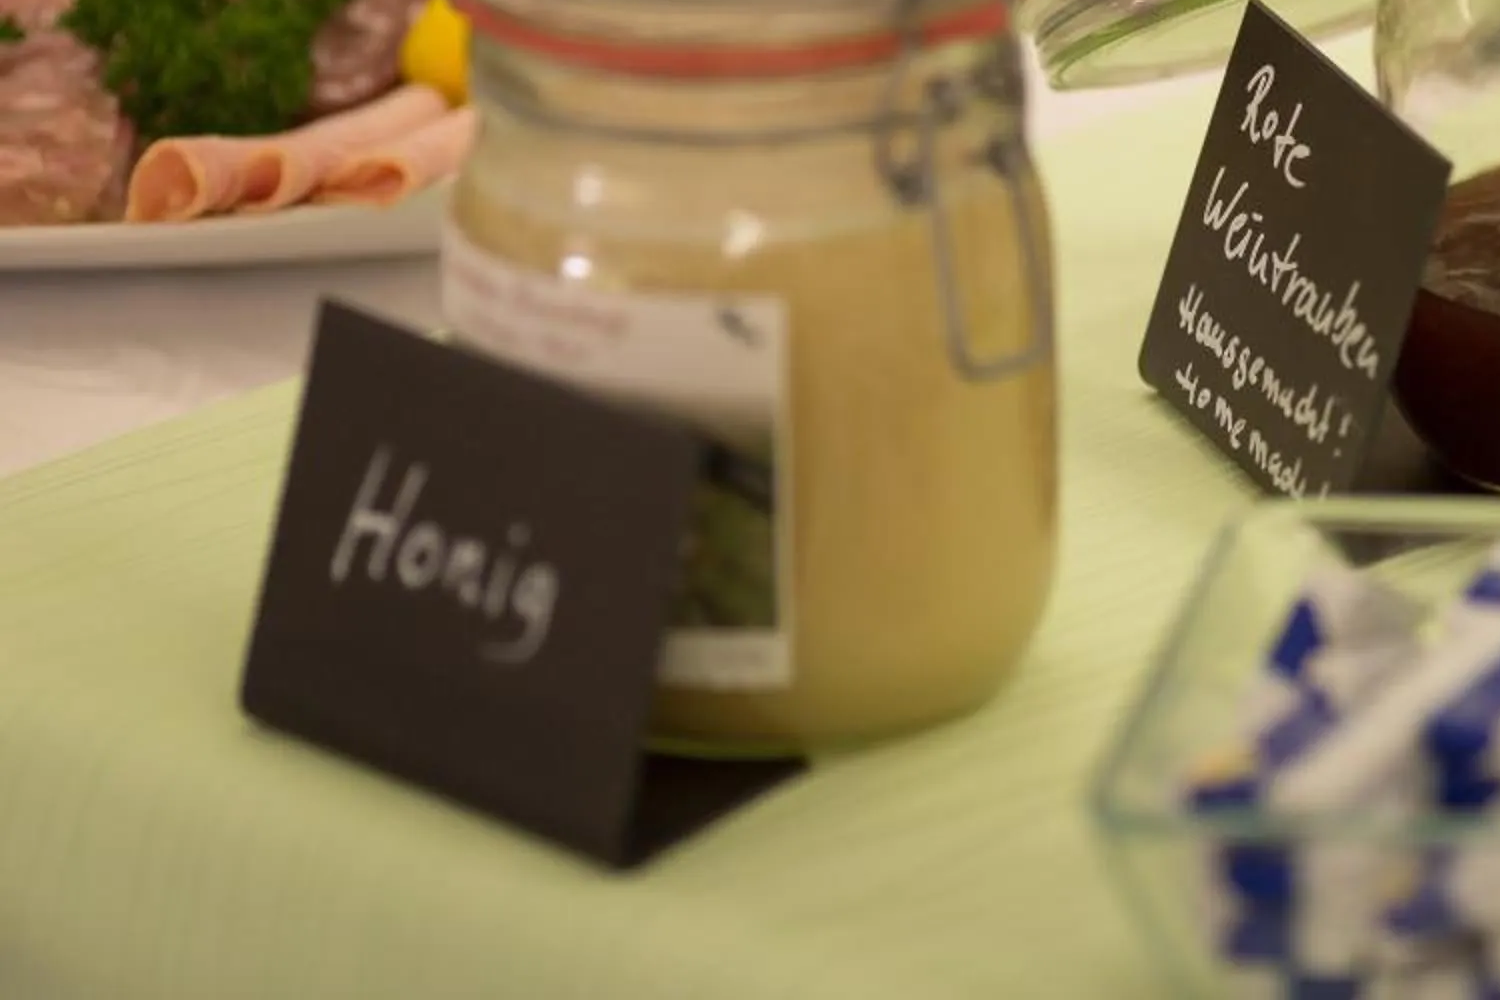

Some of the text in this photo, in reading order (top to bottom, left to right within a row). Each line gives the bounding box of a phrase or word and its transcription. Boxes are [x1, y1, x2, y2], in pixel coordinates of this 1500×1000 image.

[1241, 64, 1312, 187] Rote
[1203, 166, 1379, 380] Weintrauben
[329, 444, 560, 664] Honig
